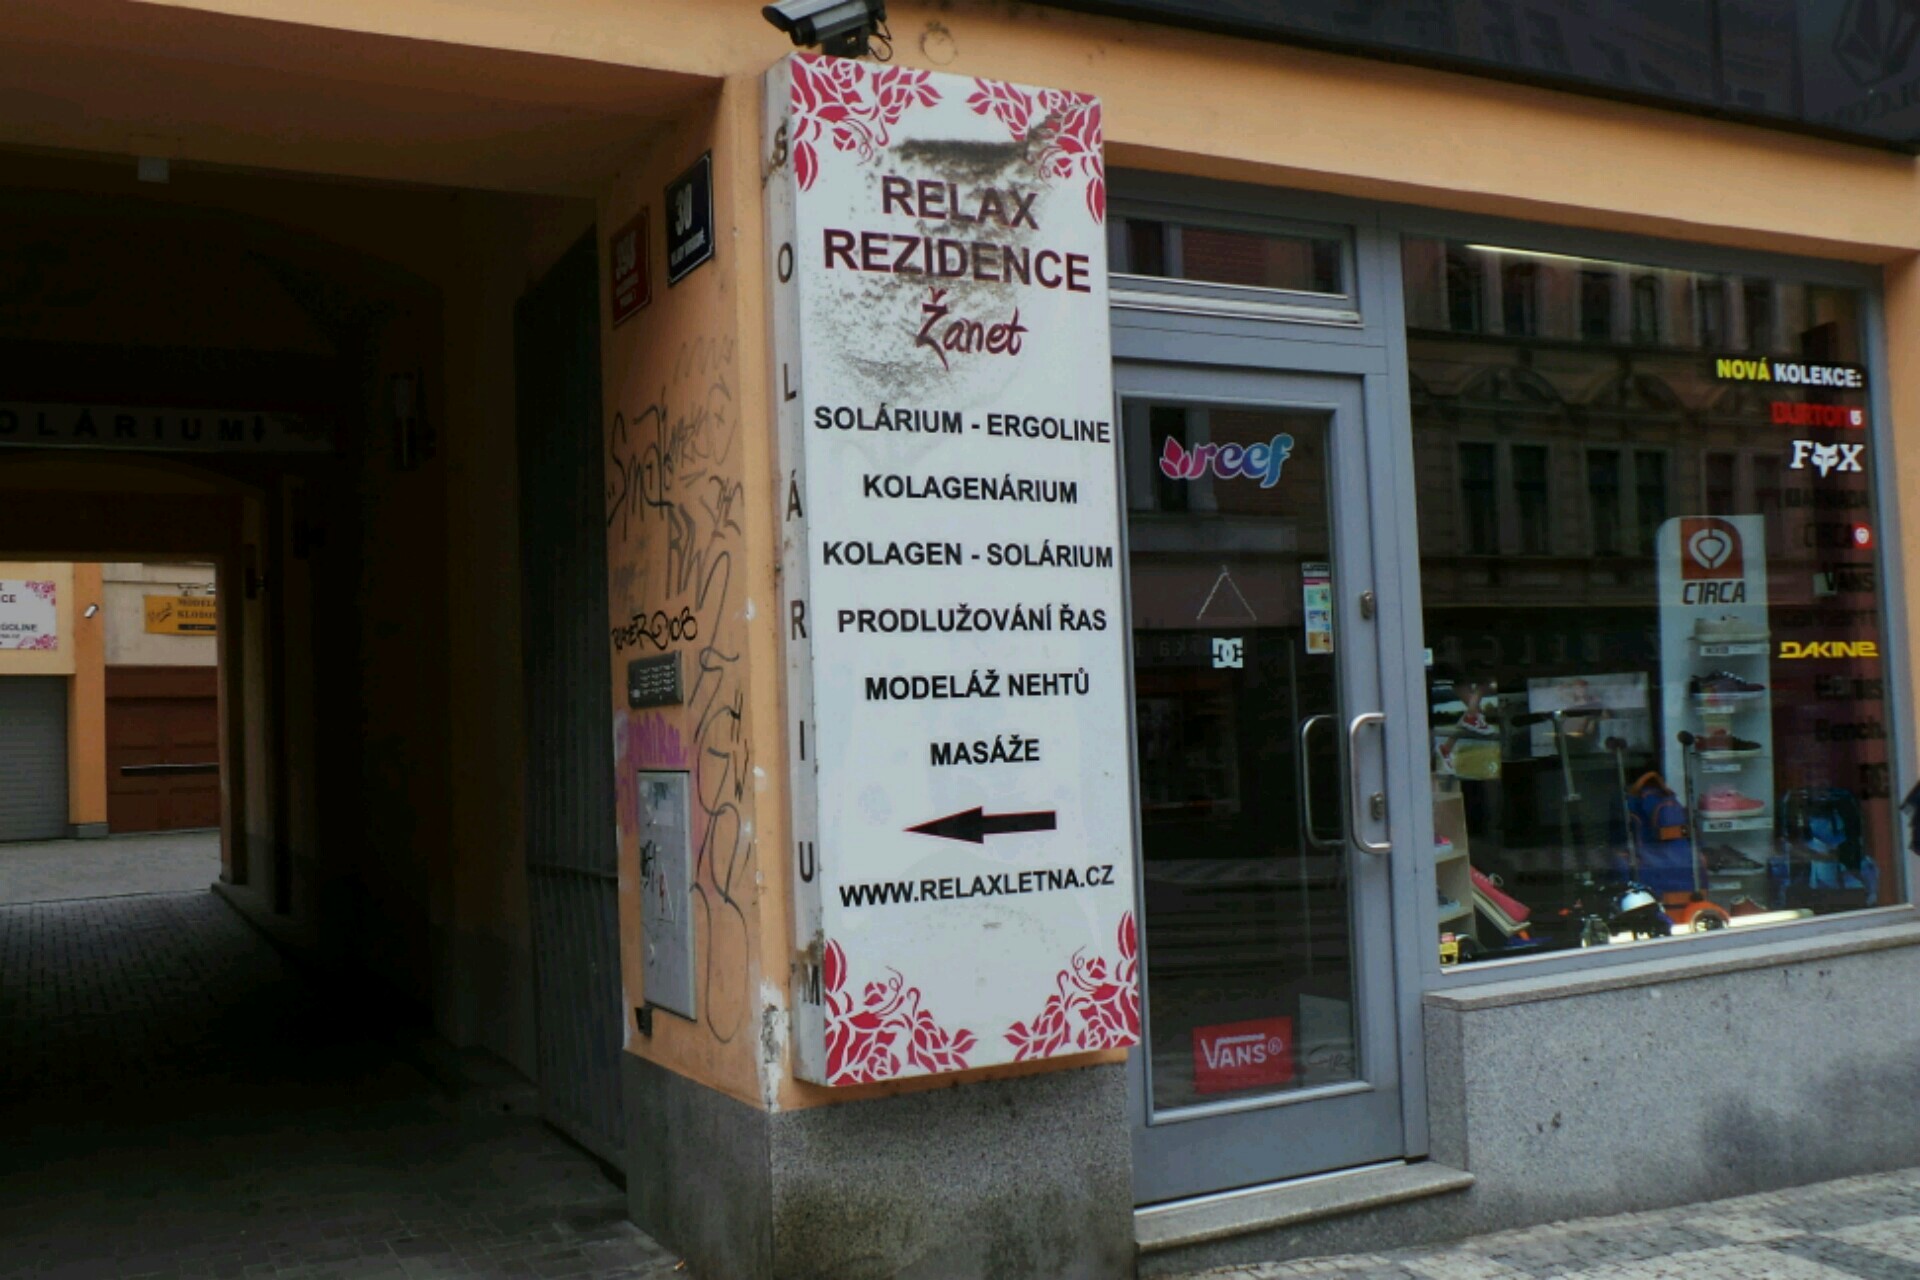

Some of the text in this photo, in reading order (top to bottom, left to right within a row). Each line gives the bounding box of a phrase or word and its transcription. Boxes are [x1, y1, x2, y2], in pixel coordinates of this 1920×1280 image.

[881, 175, 1038, 229] RELAX
[823, 228, 1092, 293] REZIDENCE
[916, 286, 1029, 371] Žanet
[1716, 358, 1863, 388] NOVÁ KOLEKCE:
[814, 402, 963, 434] SOLÁRIUM
[986, 412, 1111, 443] ERGOLINE
[1187, 433, 1295, 489] reef
[863, 473, 1078, 504] KOLAGENÁRIUM
[823, 541, 962, 566] KOLAGEN
[986, 539, 1113, 568] SOLÁRIUM
[1683, 582, 1745, 604] CIRCA
[838, 603, 1107, 633] PRODLUŽOVÁNÍ ŘAS
[1778, 641, 1879, 658] DAKINE
[865, 667, 1089, 701] MODELÁŽ NEHTŮ
[930, 734, 1040, 766] MASÁŽE
[839, 864, 1115, 907] WWW.RELAXLETNA.CZ
[1201, 1033, 1268, 1070] VANS
